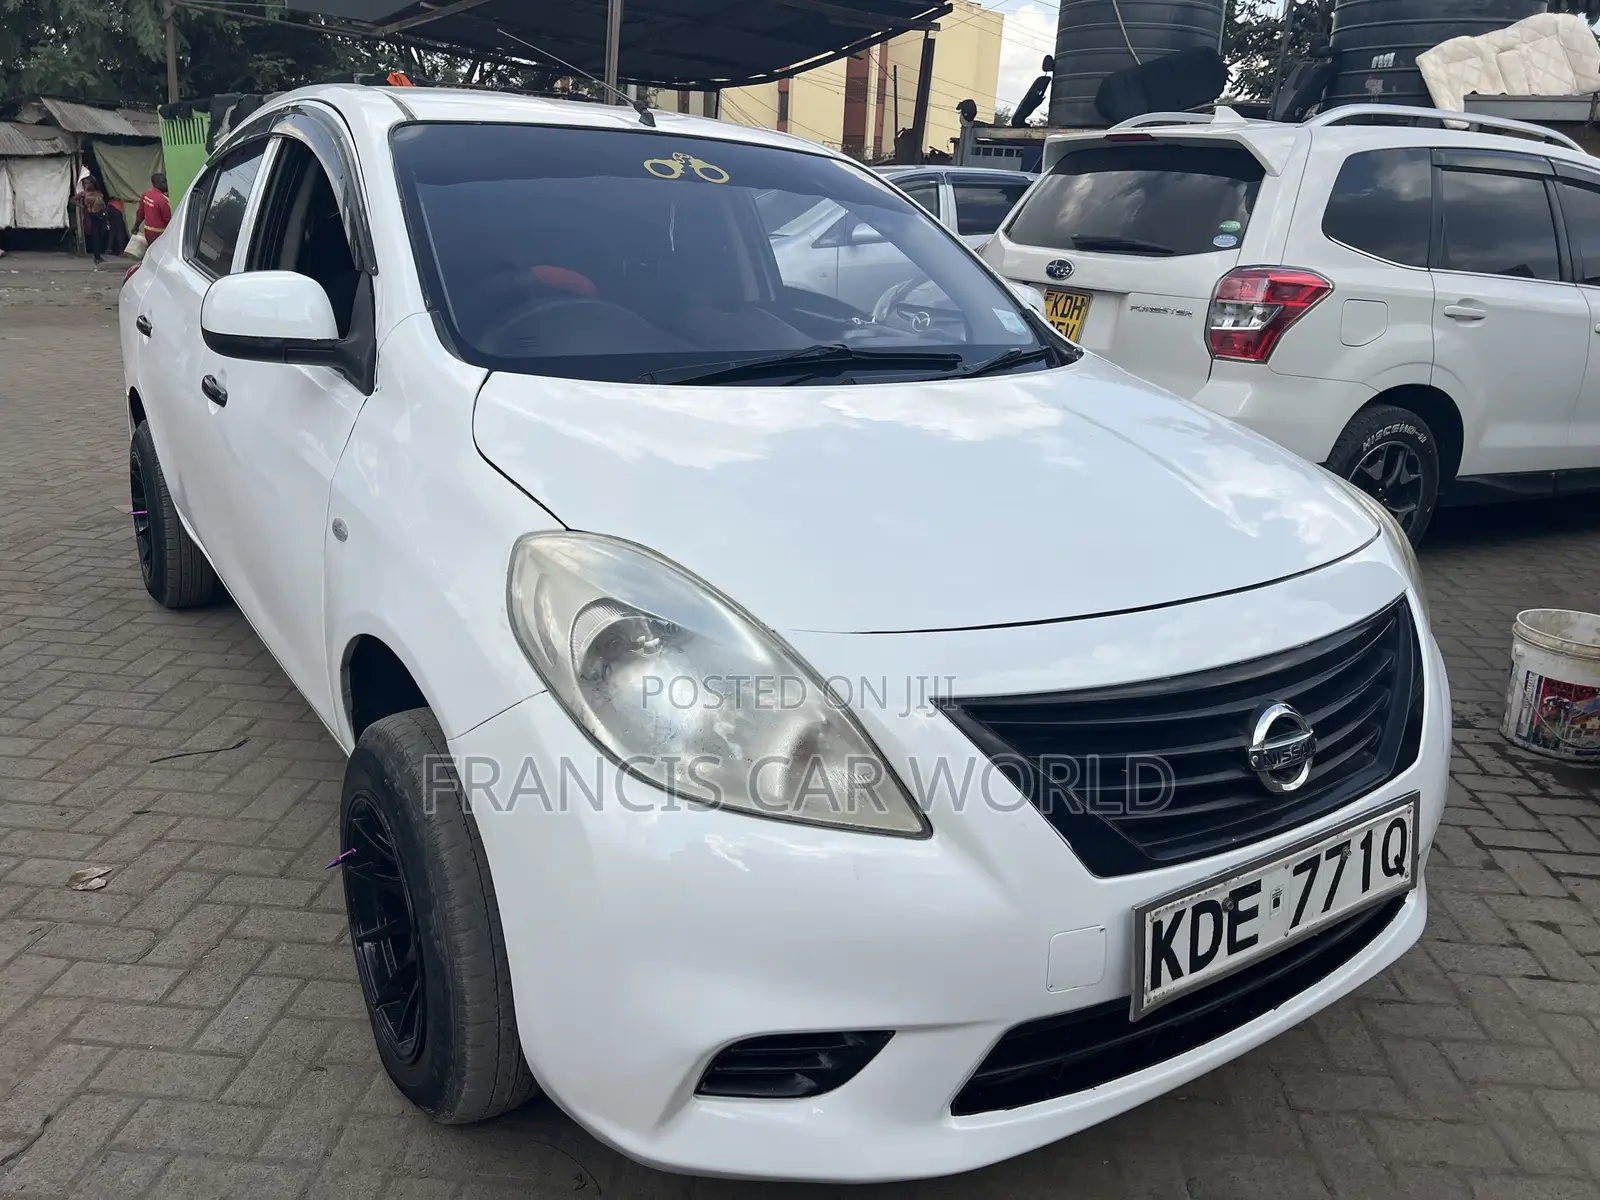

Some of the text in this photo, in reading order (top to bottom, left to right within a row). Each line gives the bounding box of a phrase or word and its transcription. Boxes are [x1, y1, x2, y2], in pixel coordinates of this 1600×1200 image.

[1050, 293, 1086, 321] KDH
[1263, 738, 1317, 769] NISSAN
[1149, 816, 1408, 992] KDE 771Q
